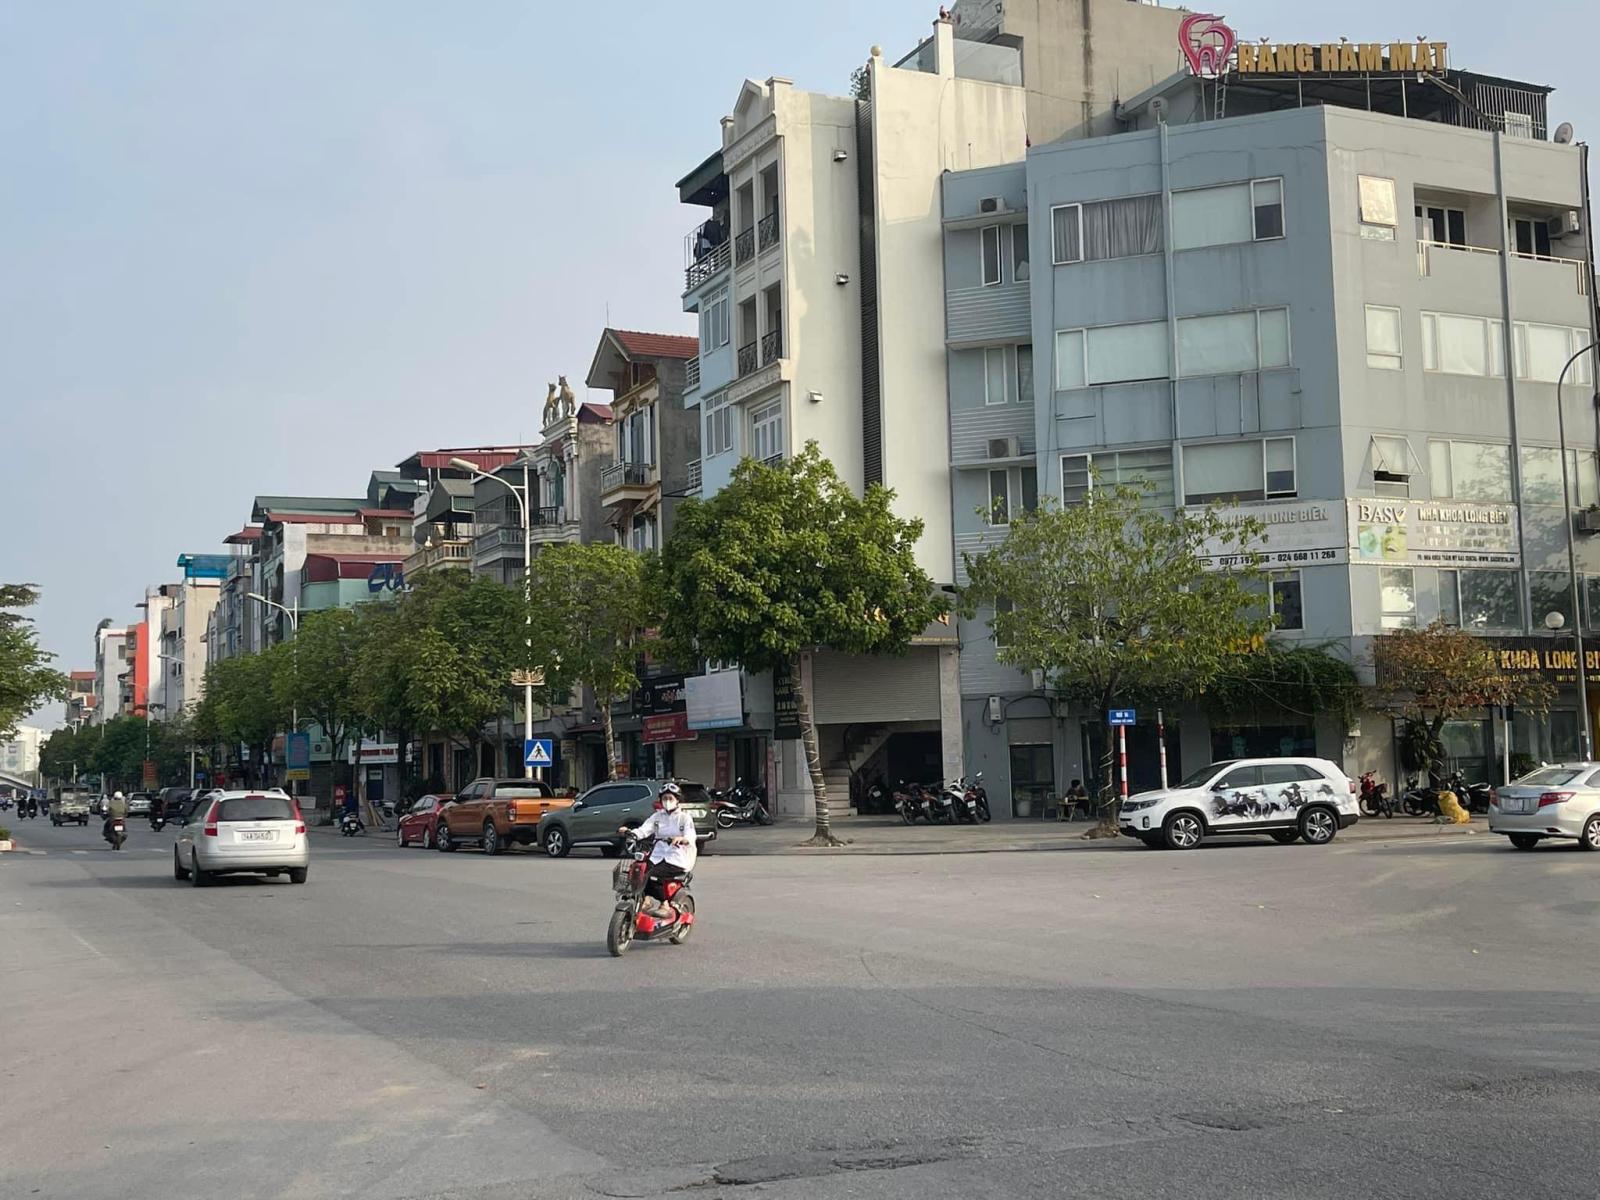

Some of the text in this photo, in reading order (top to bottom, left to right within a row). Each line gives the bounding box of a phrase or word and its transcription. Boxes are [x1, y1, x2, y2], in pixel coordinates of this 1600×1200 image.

[1238, 37, 1314, 72] RĂNG
[1320, 37, 1383, 72] HÀM
[1266, 510, 1296, 524] LONG
